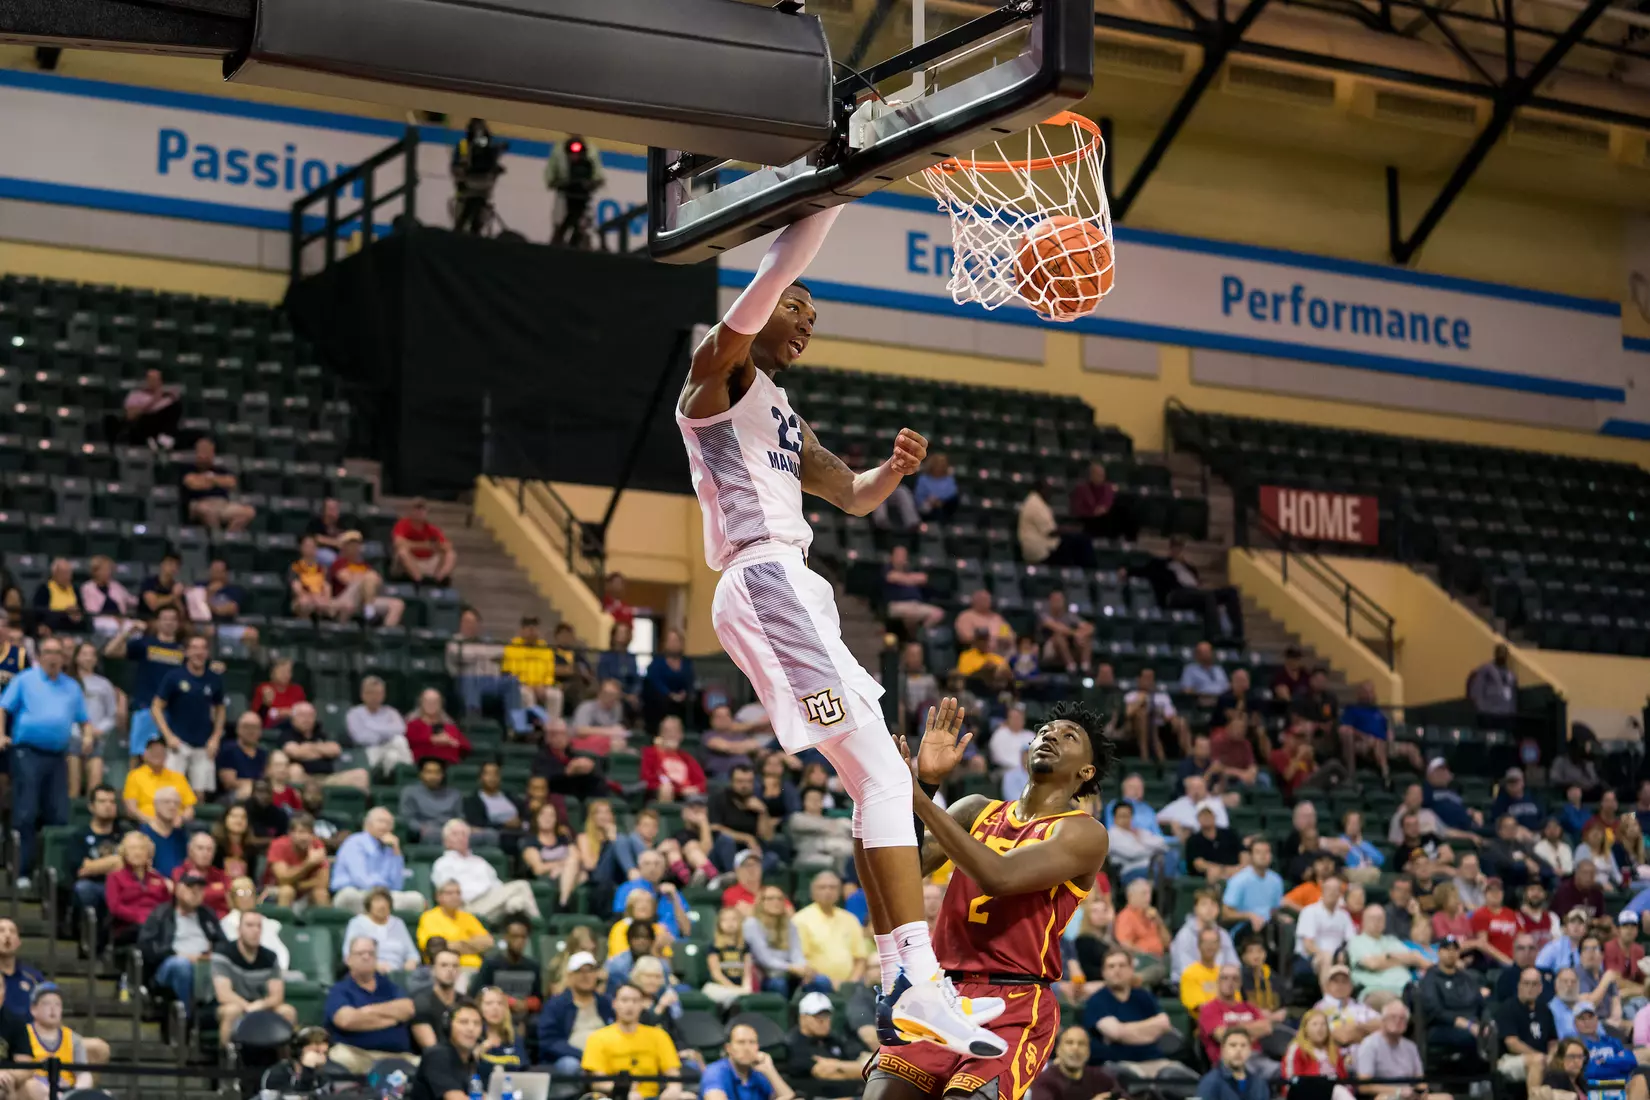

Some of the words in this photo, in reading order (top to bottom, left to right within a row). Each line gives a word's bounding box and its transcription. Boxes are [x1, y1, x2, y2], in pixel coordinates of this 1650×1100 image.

[157, 128, 364, 198] Passion
[1221, 274, 1471, 350] Performance
[1278, 489, 1362, 542] HOME
[800, 688, 846, 728] MU
